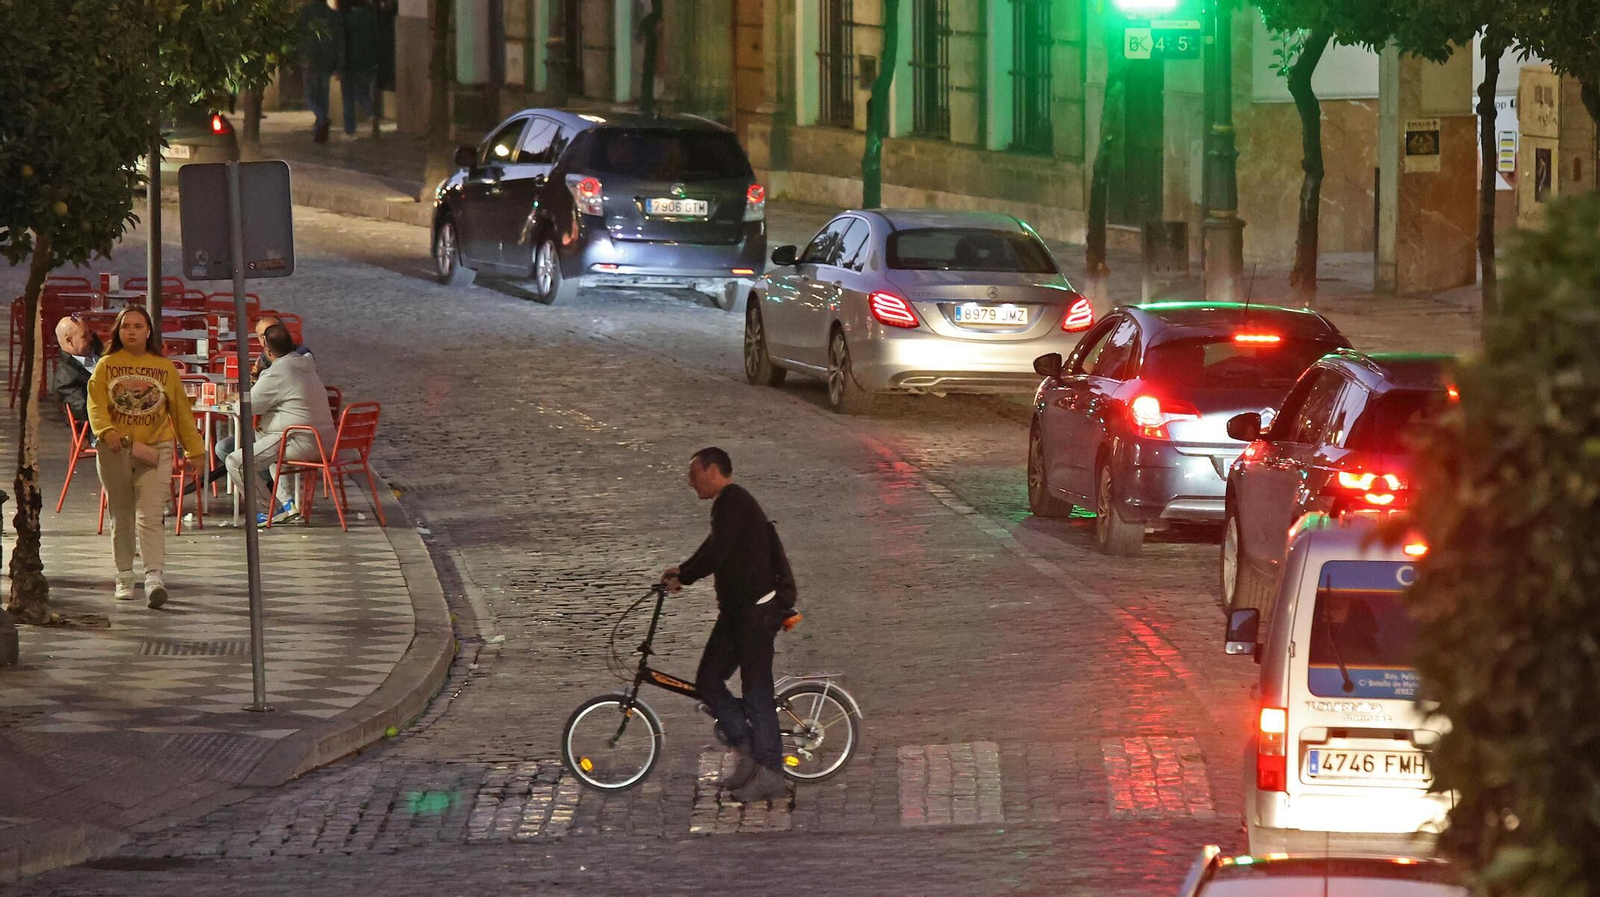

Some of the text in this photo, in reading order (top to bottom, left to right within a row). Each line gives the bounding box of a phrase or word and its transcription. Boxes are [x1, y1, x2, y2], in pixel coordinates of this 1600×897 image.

[1155, 37, 1165, 51] 4
[1178, 36, 1188, 51] 5
[654, 201, 706, 214] 7906 GTM
[964, 308, 1024, 322] 8979 JMZ
[106, 364, 133, 380] MONTE
[135, 366, 169, 386] CERVINO
[1322, 753, 1375, 773] 4746
[1385, 754, 1425, 774] FMH
